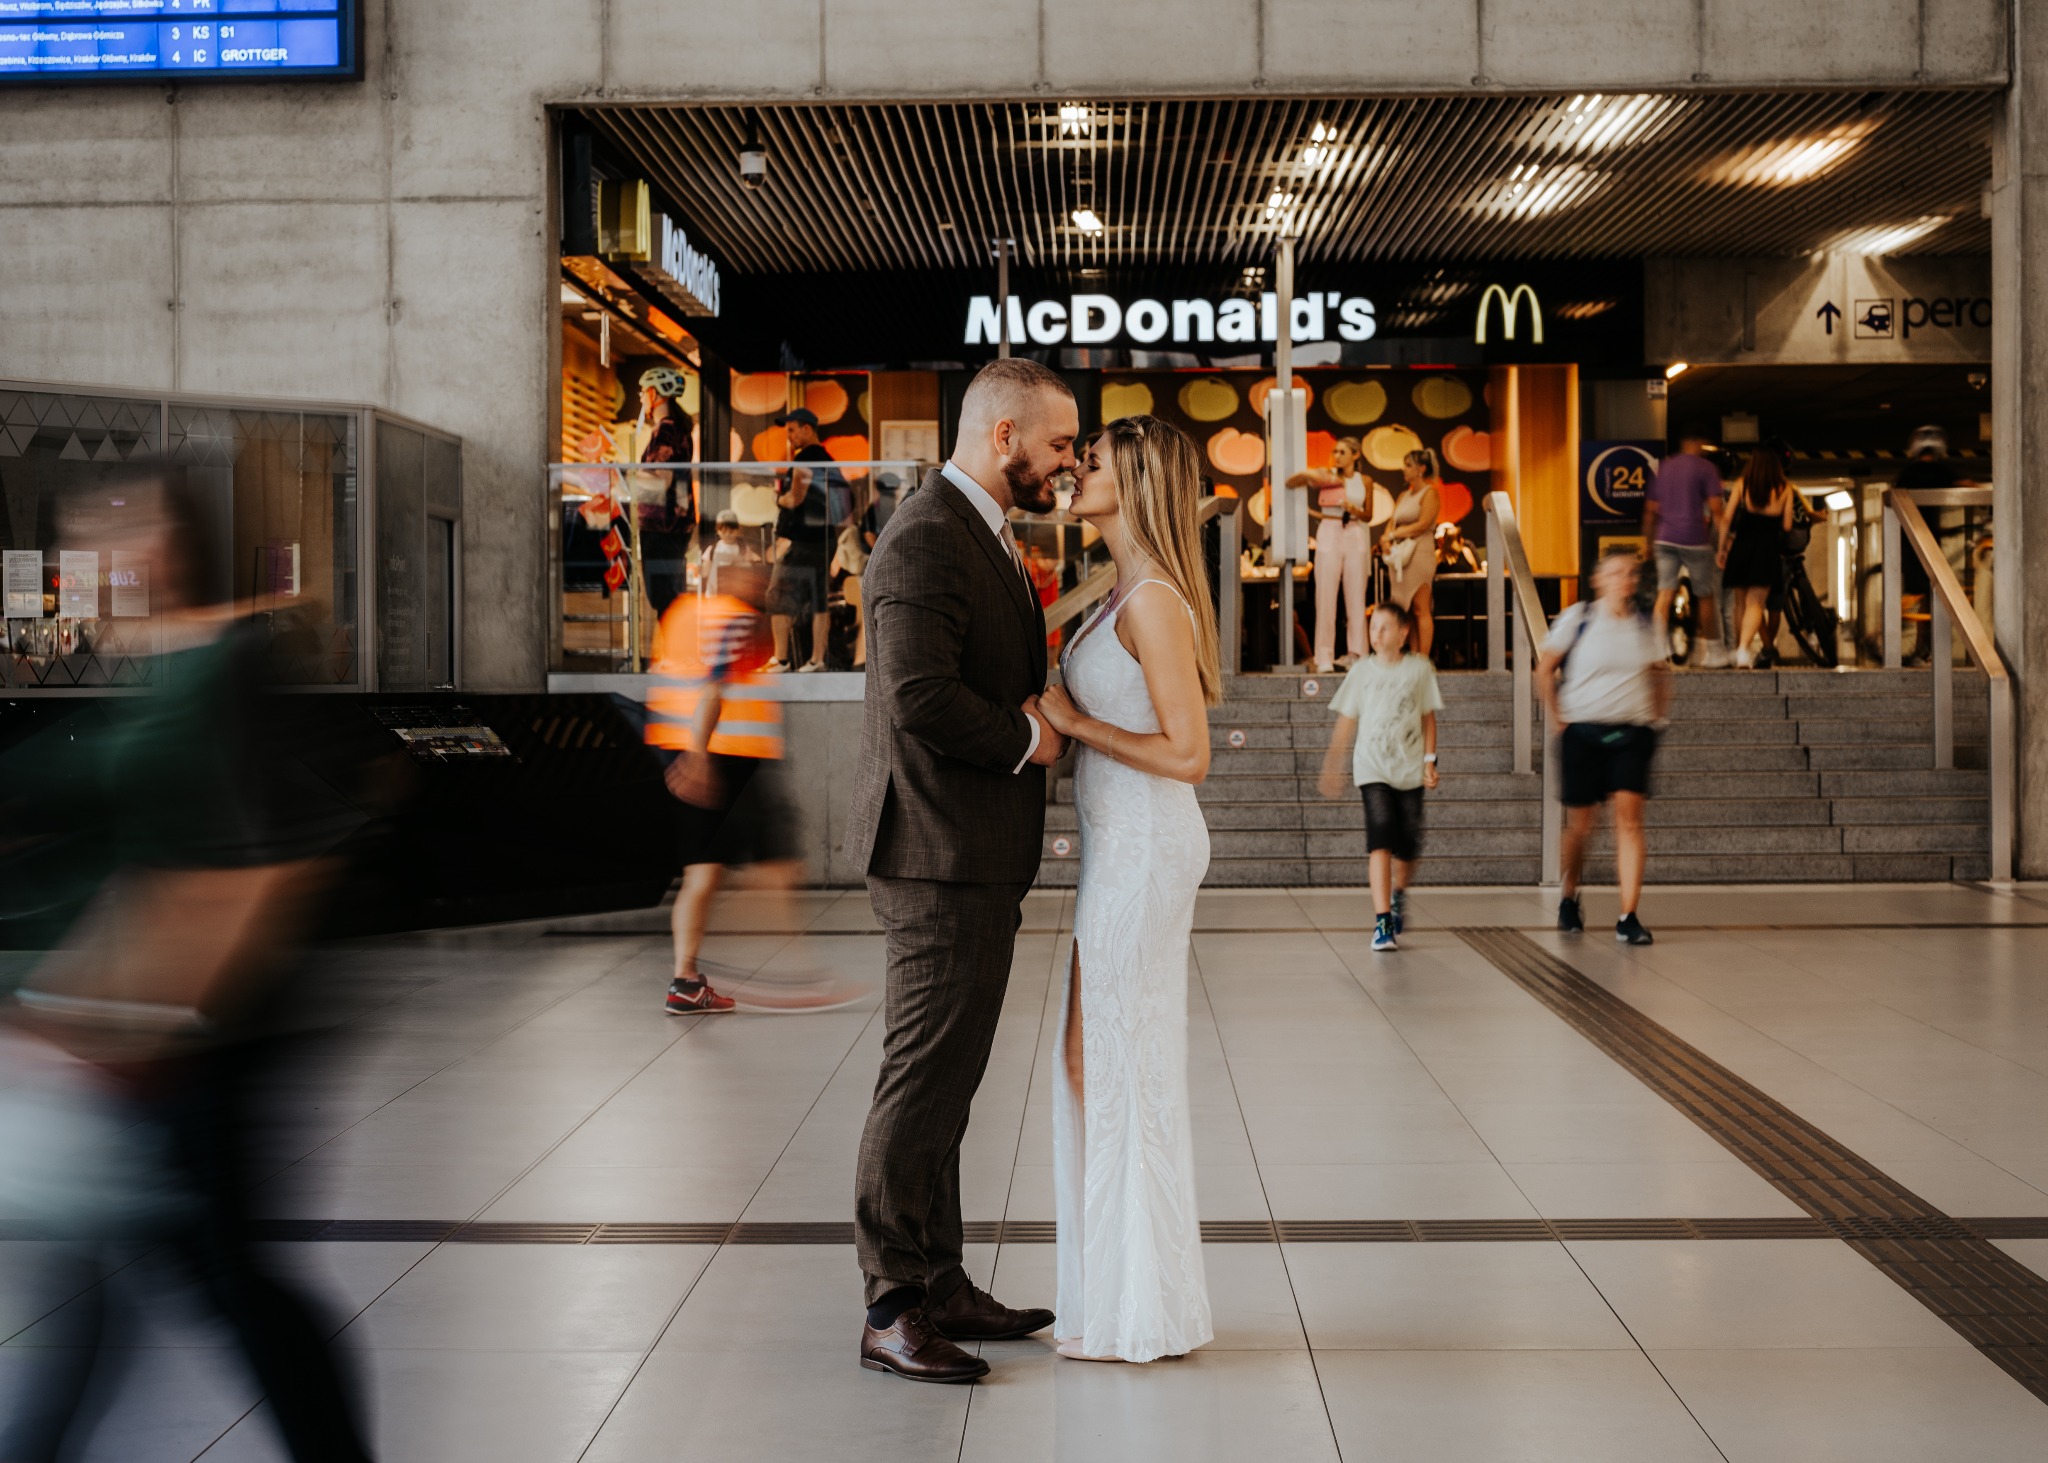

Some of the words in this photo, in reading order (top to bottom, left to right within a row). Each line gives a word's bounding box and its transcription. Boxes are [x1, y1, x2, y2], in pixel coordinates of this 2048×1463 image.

[172, 27, 180, 40] 3
[193, 26, 210, 39] KS
[220, 26, 235, 38] S1
[172, 51, 181, 63] 4
[194, 49, 207, 63] IC
[221, 48, 288, 61] GROTTGER
[964, 291, 1376, 344] McDonald's
[1612, 466, 1646, 489] 24
